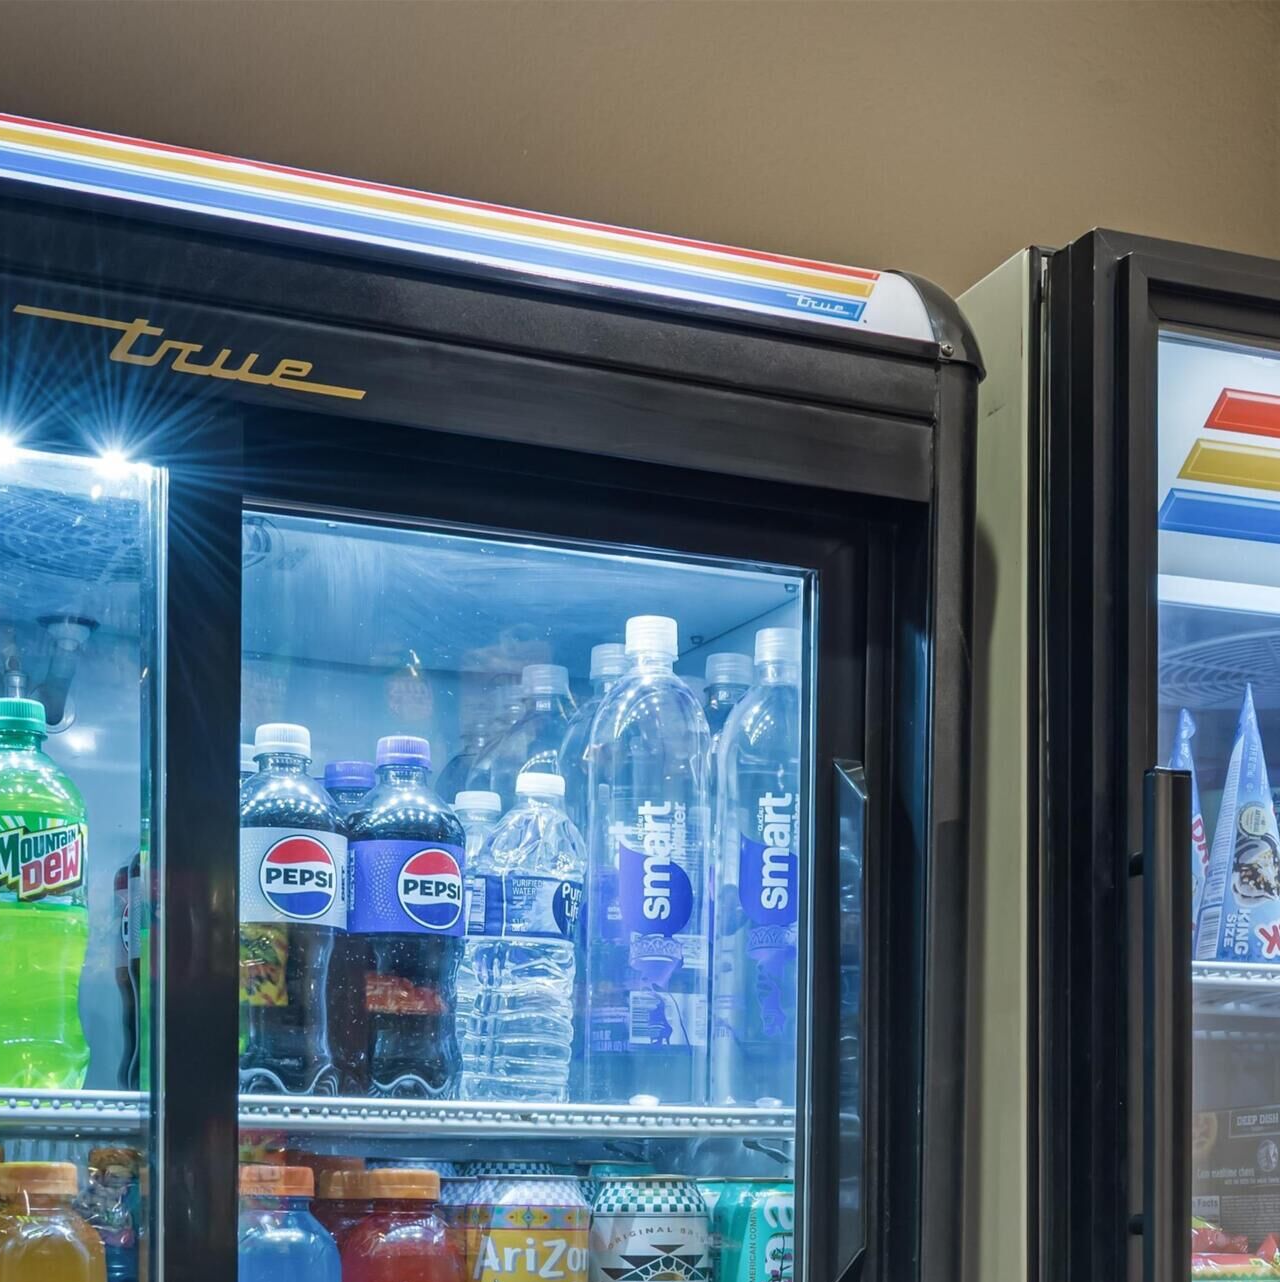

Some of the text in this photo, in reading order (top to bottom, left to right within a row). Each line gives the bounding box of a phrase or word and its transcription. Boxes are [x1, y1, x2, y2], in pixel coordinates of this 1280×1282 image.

[786, 293, 850, 315] true
[13, 304, 367, 400] true
[638, 801, 671, 920] smart
[759, 792, 792, 910] smart
[265, 867, 333, 889] PEPSI
[403, 879, 461, 901] PEPSI
[1224, 912, 1236, 949] SIZE
[1234, 908, 1251, 956] KING
[1236, 1112, 1279, 1126] DEEP DISH
[608, 1227, 673, 1250] ORIGINAL
